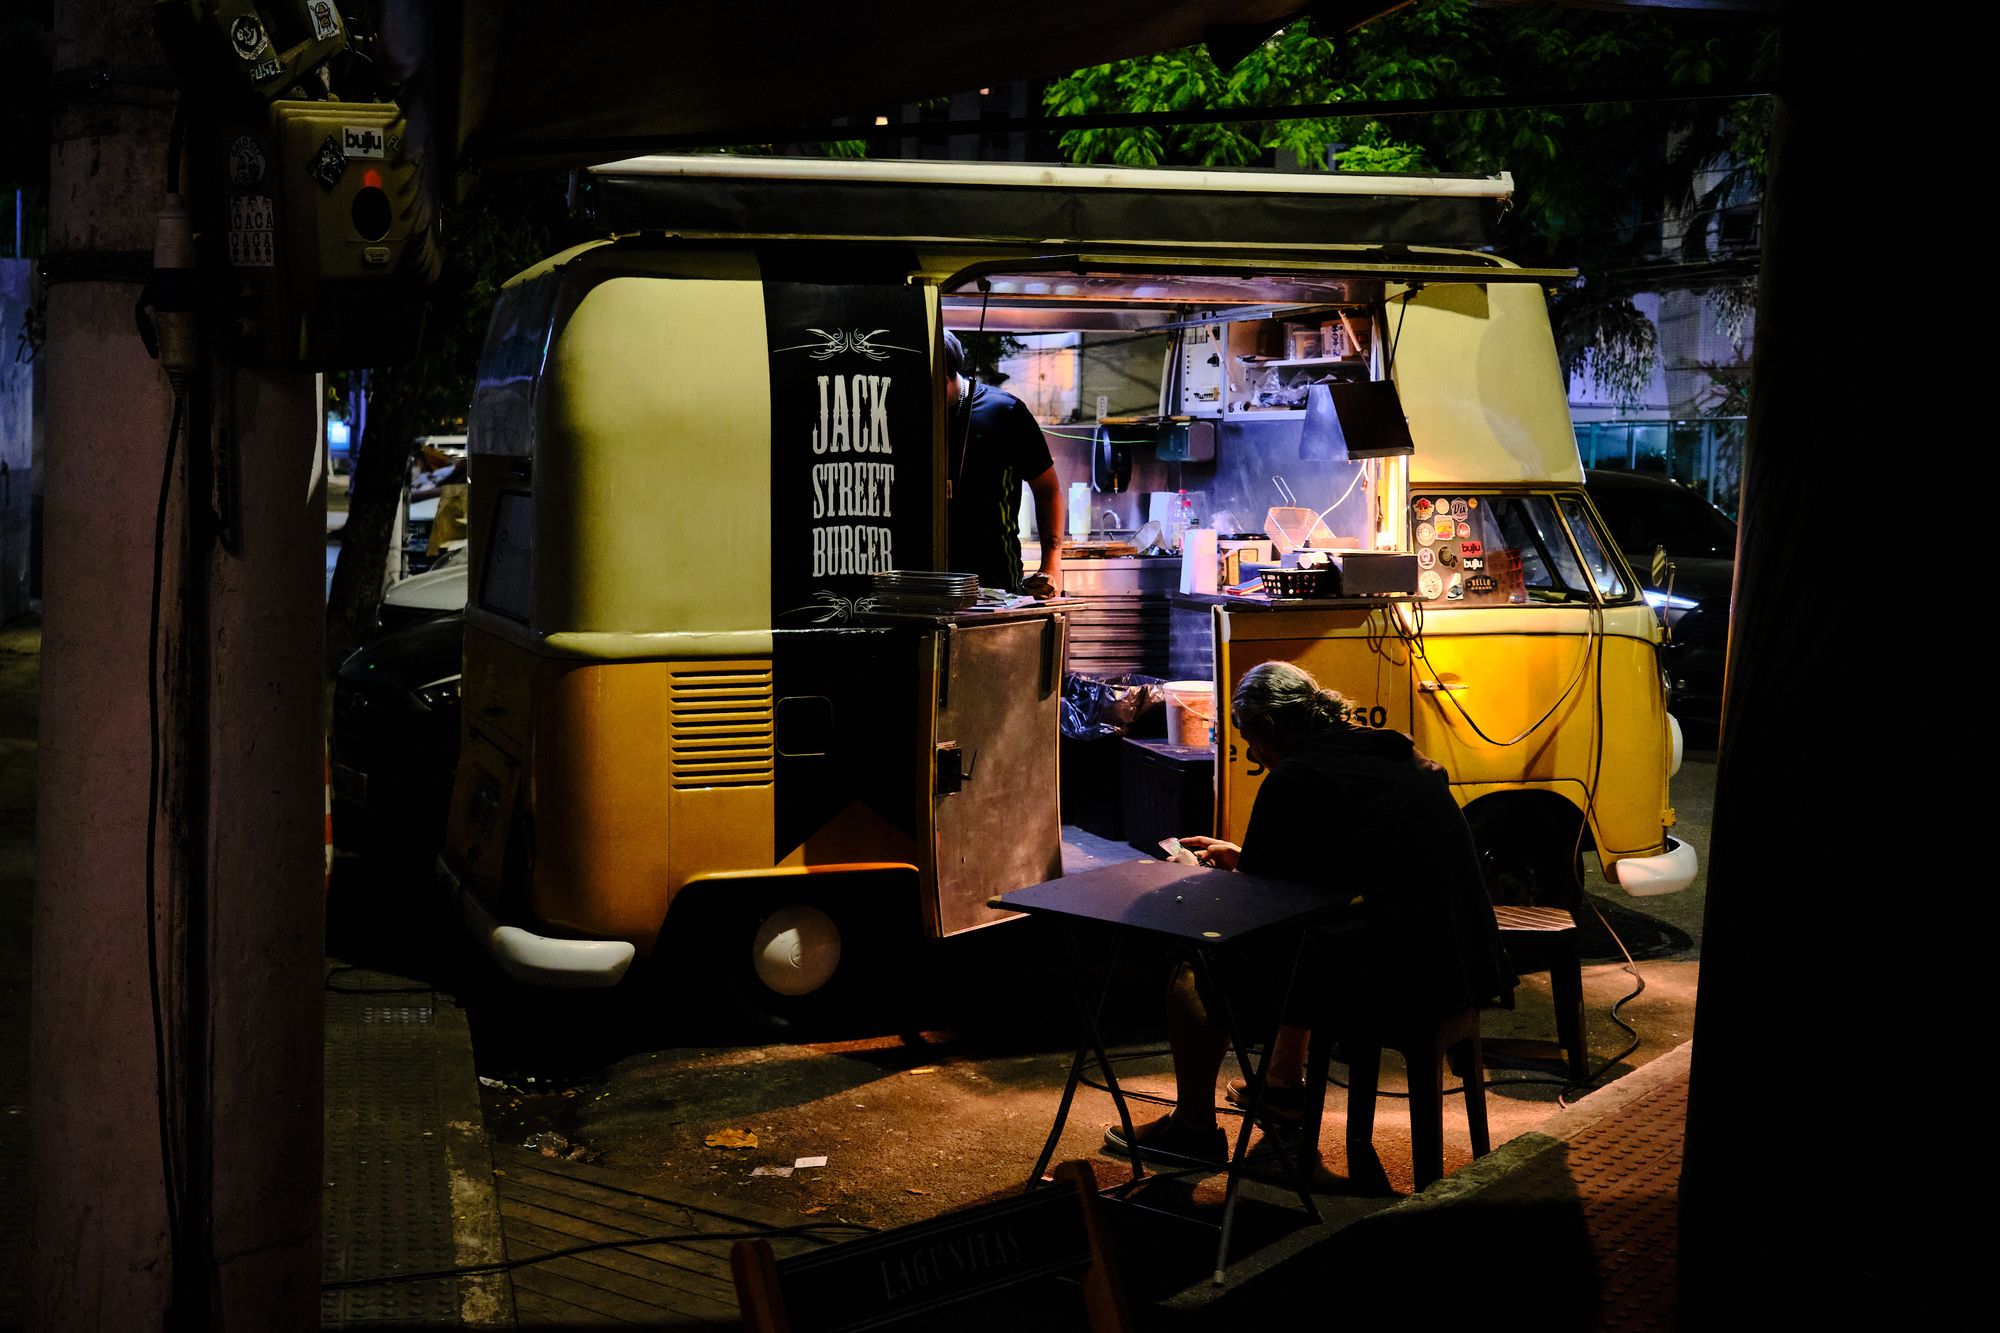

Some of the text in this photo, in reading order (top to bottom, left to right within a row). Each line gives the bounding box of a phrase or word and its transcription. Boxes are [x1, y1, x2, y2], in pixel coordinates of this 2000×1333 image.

[234, 213, 274, 229] CACA
[812, 374, 892, 454] JACK
[812, 462, 894, 519] STREET
[812, 525, 893, 578] BURGER
[880, 1223, 1021, 1300] LAGUNITAS
